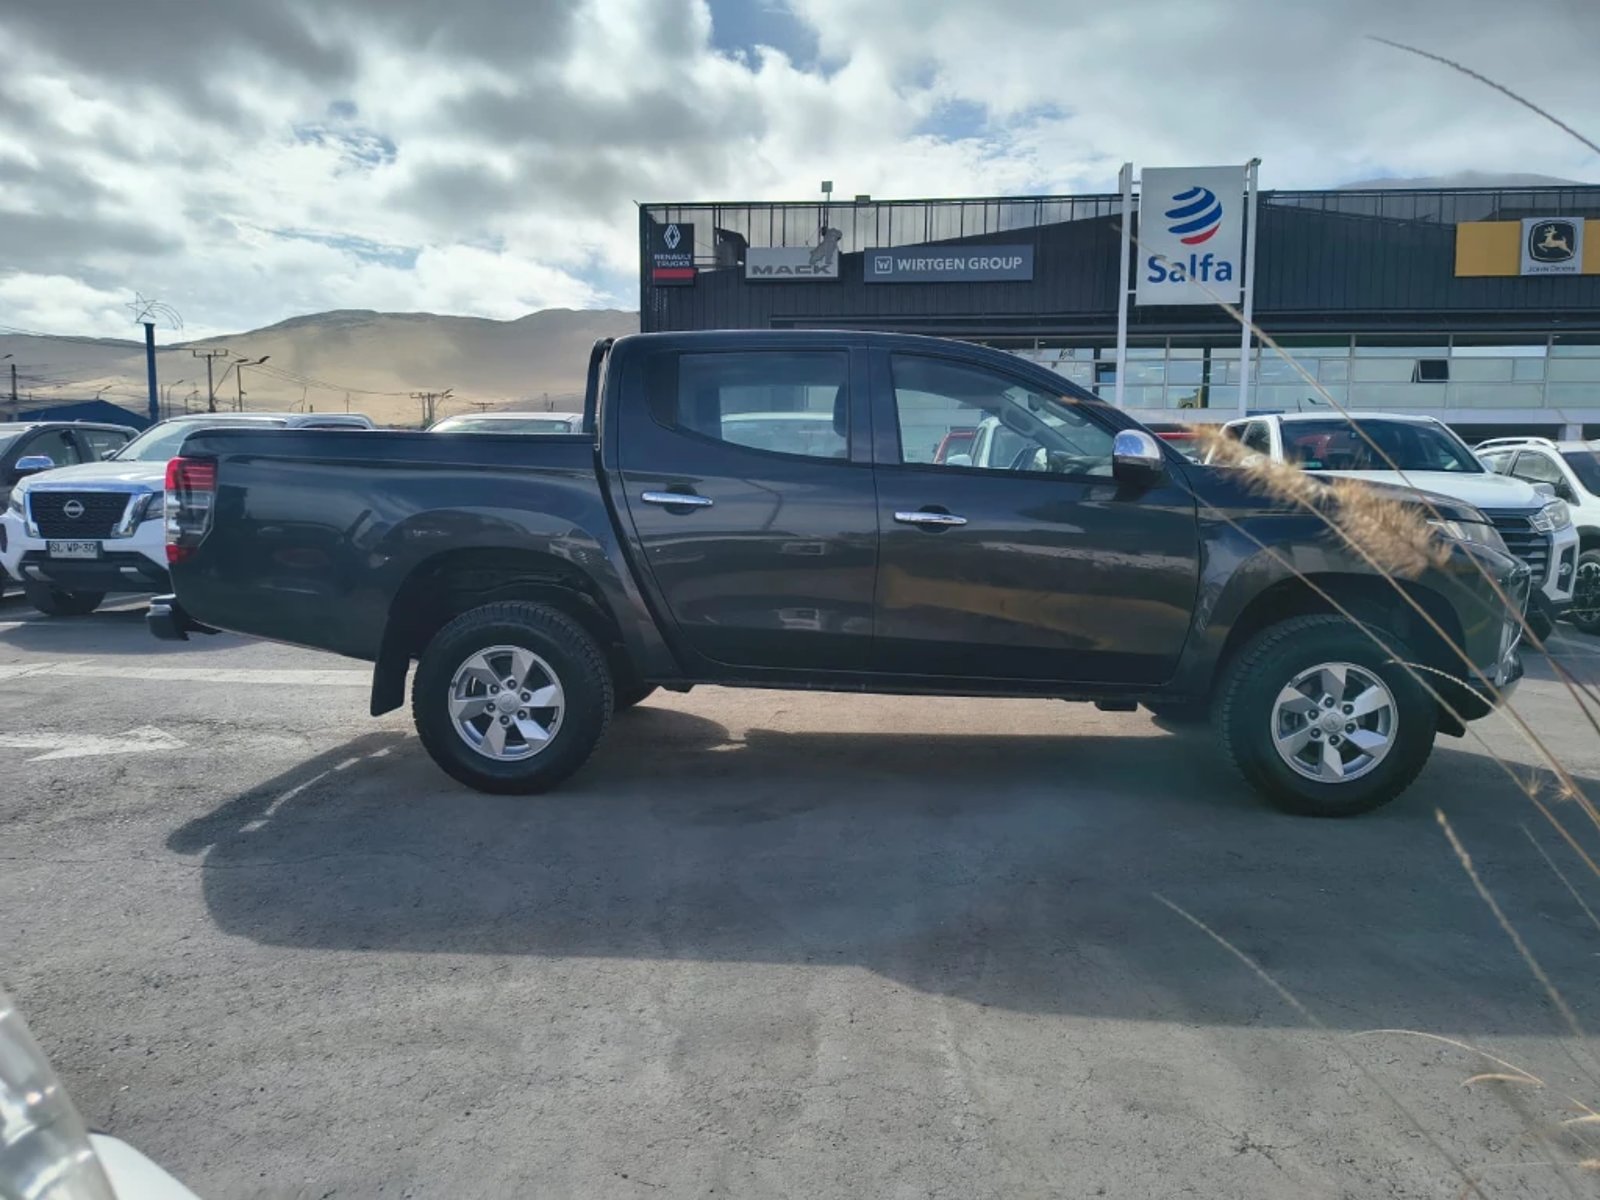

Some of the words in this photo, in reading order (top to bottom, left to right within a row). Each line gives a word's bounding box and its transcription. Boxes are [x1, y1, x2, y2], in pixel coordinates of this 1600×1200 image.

[751, 264, 832, 275] MACK
[897, 258, 965, 271] WIRTGEN
[968, 257, 1023, 270] GROUP
[1147, 253, 1232, 283] Salfa
